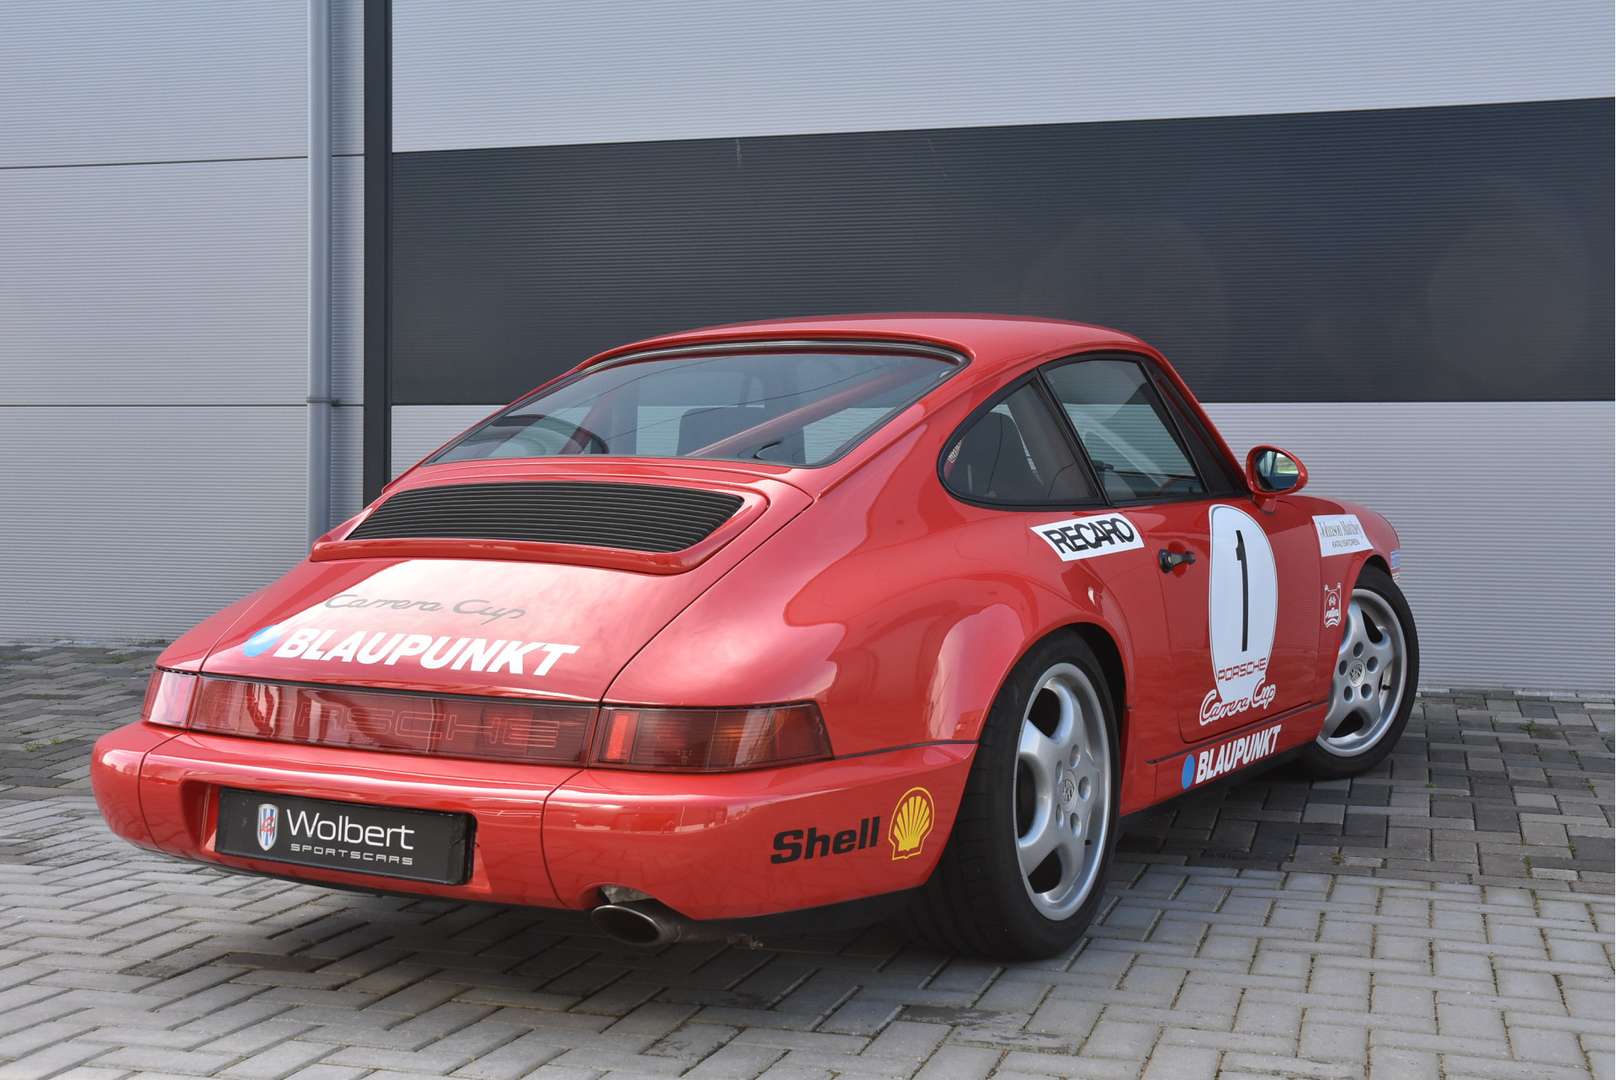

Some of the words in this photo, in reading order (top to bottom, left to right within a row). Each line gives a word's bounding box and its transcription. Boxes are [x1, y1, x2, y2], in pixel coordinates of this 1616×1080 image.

[1042, 518, 1134, 553] RECARO
[324, 594, 444, 613] Carrera
[452, 599, 526, 625] Cup
[1235, 529, 1249, 652] 1
[274, 628, 580, 676] BLAUPUNKT
[1217, 657, 1267, 684] PORSCHE
[1252, 677, 1277, 710] Cup
[245, 699, 562, 749] RSCHE
[1195, 724, 1282, 785] BLAUPUNKT
[286, 808, 415, 850] Wolbert
[770, 816, 880, 864] Shell
[290, 843, 413, 866] SPORTSCARS
